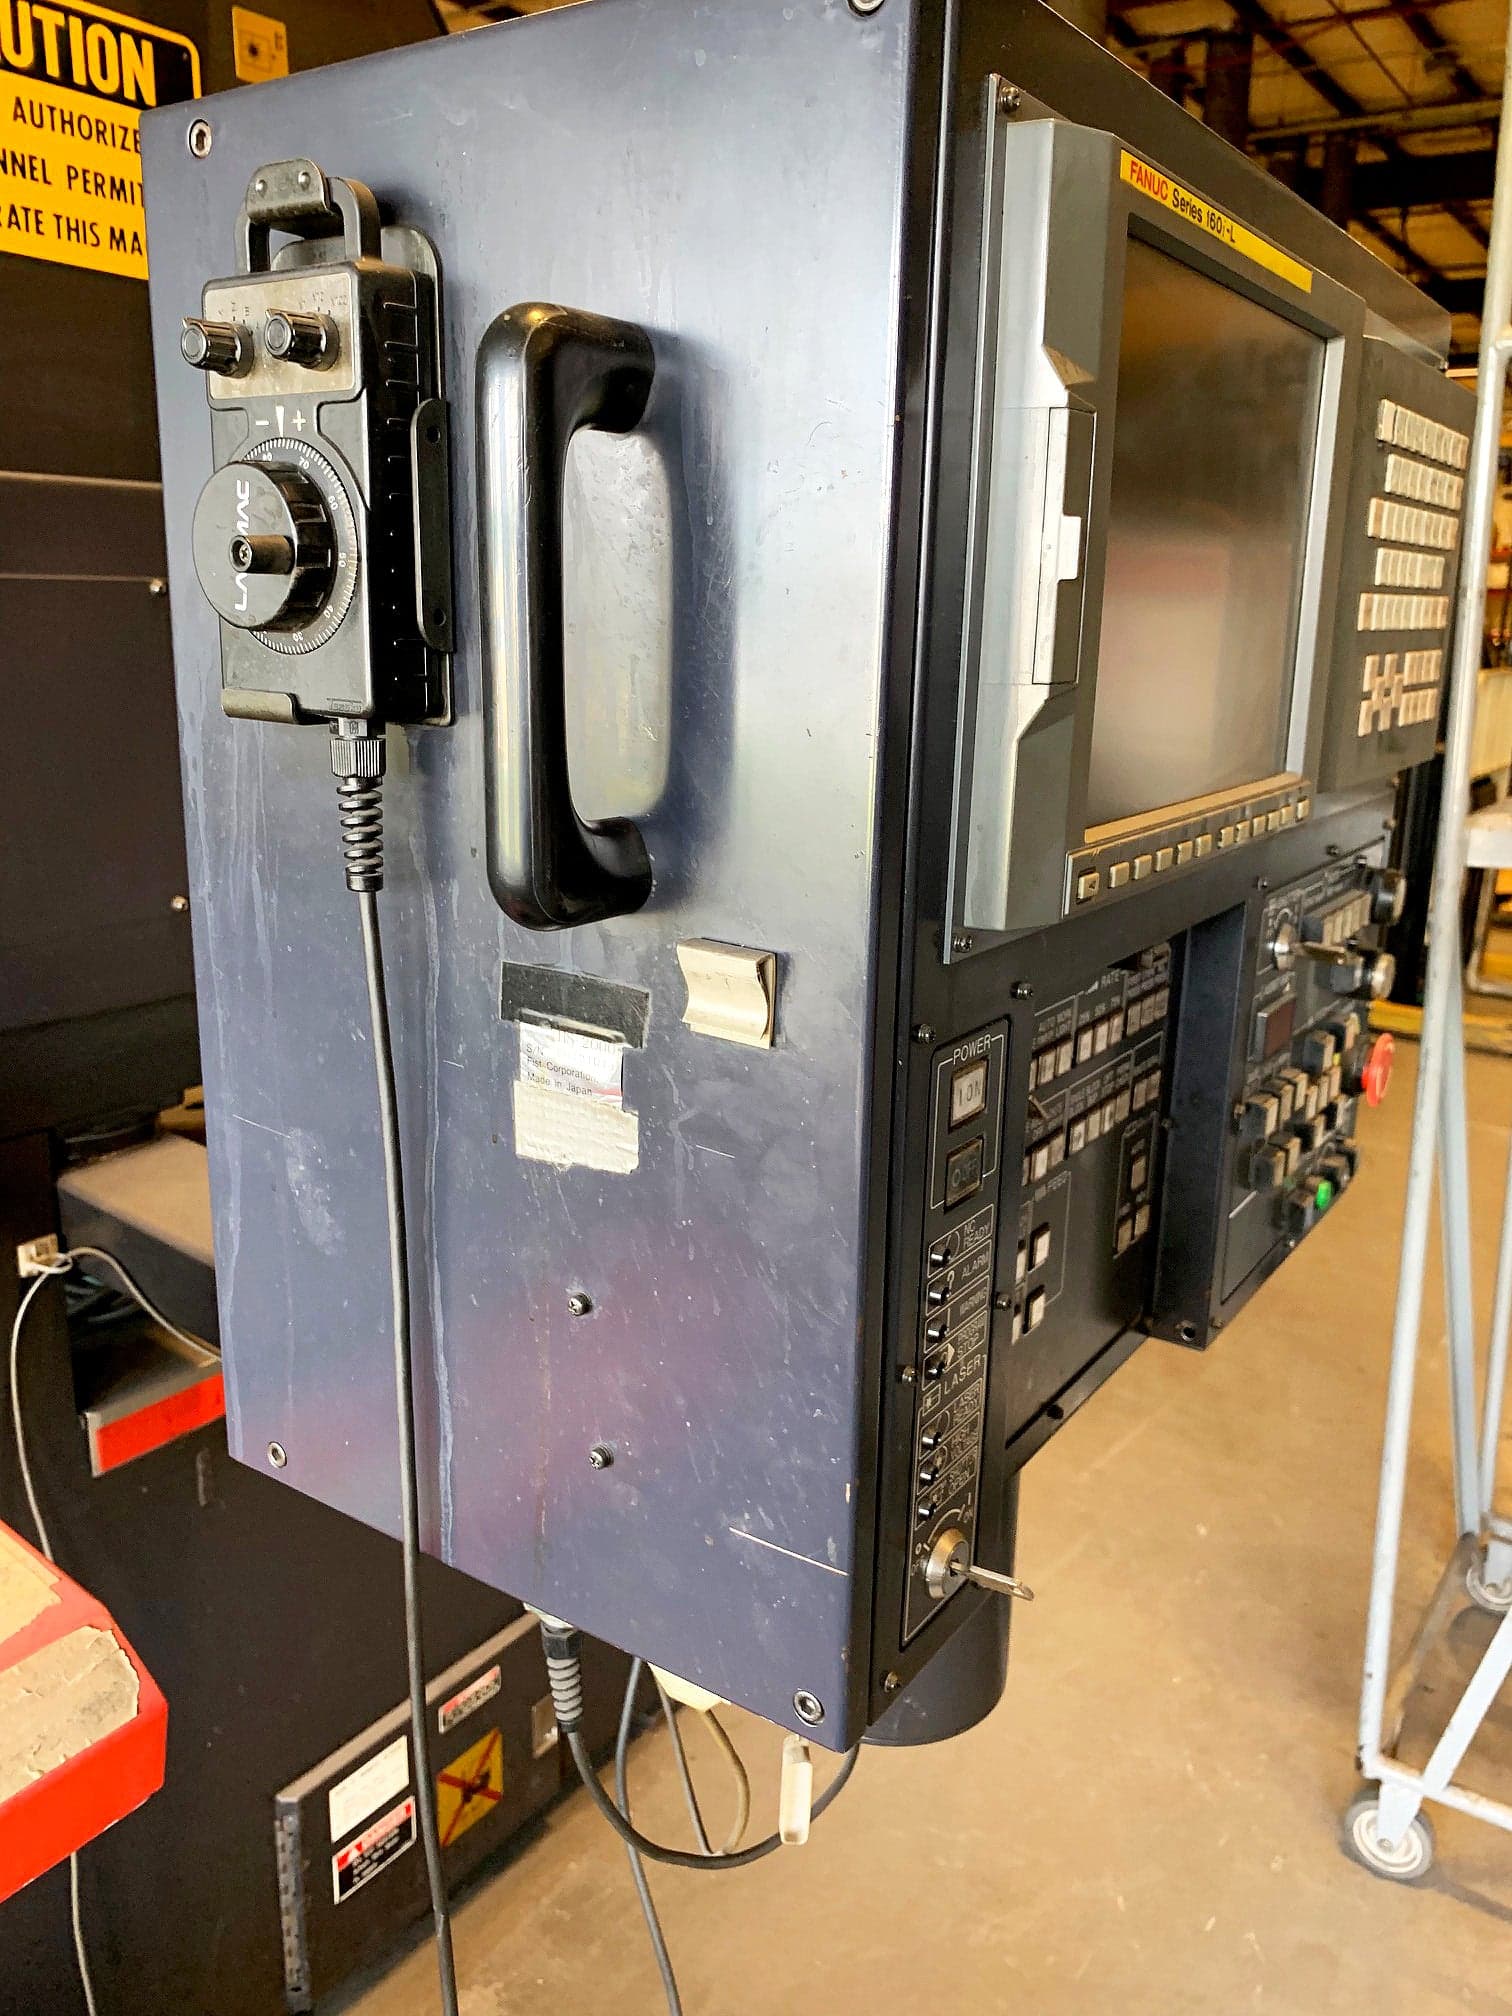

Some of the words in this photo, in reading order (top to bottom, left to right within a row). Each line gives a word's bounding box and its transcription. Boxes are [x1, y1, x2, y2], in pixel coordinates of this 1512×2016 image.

[0, 1, 157, 107] UTION
[1129, 160, 1169, 201] FANUC
[1172, 188, 1203, 224] Series
[0, 203, 45, 236] ATE
[53, 213, 100, 247] THIS
[109, 226, 143, 256] MA
[299, 455, 310, 470] 70
[328, 496, 339, 511] 60
[234, 479, 250, 611] LAMAC
[323, 605, 334, 619] 40
[953, 1033, 991, 1065] POWER
[527, 1071, 550, 1086] Made
[566, 1081, 593, 1097] Japan
[964, 1219, 976, 1235] NC
[964, 1222, 990, 1250] READY
[962, 1250, 990, 1280] ALARM
[957, 1331, 980, 1358] STOP
[943, 1353, 982, 1395] LASER
